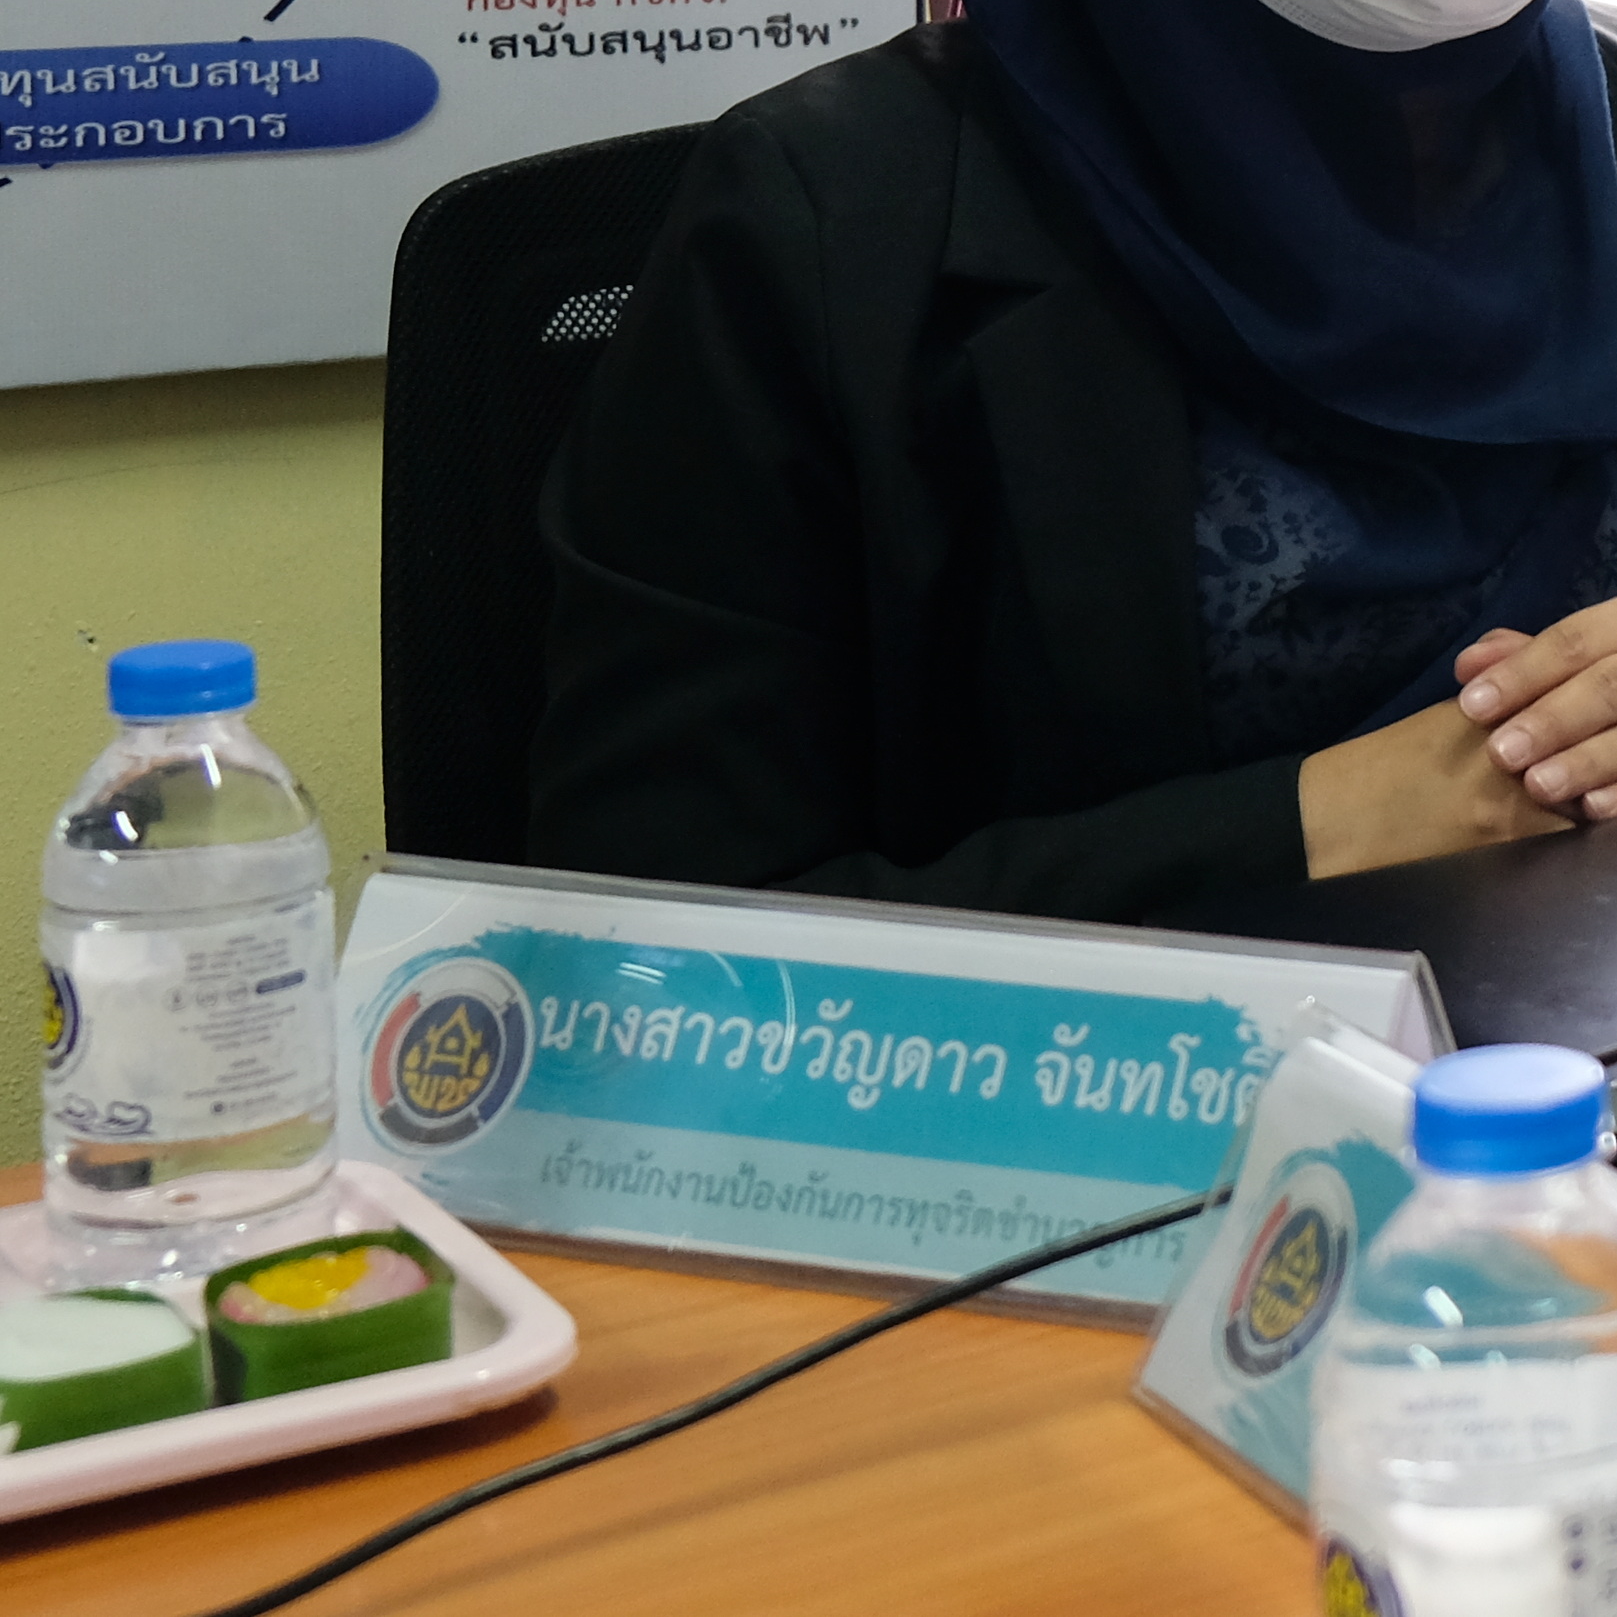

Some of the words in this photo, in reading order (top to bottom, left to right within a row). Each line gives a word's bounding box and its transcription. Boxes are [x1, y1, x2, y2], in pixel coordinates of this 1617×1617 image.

[540, 995, 1007, 1111] นางสาวขวัญดาว
